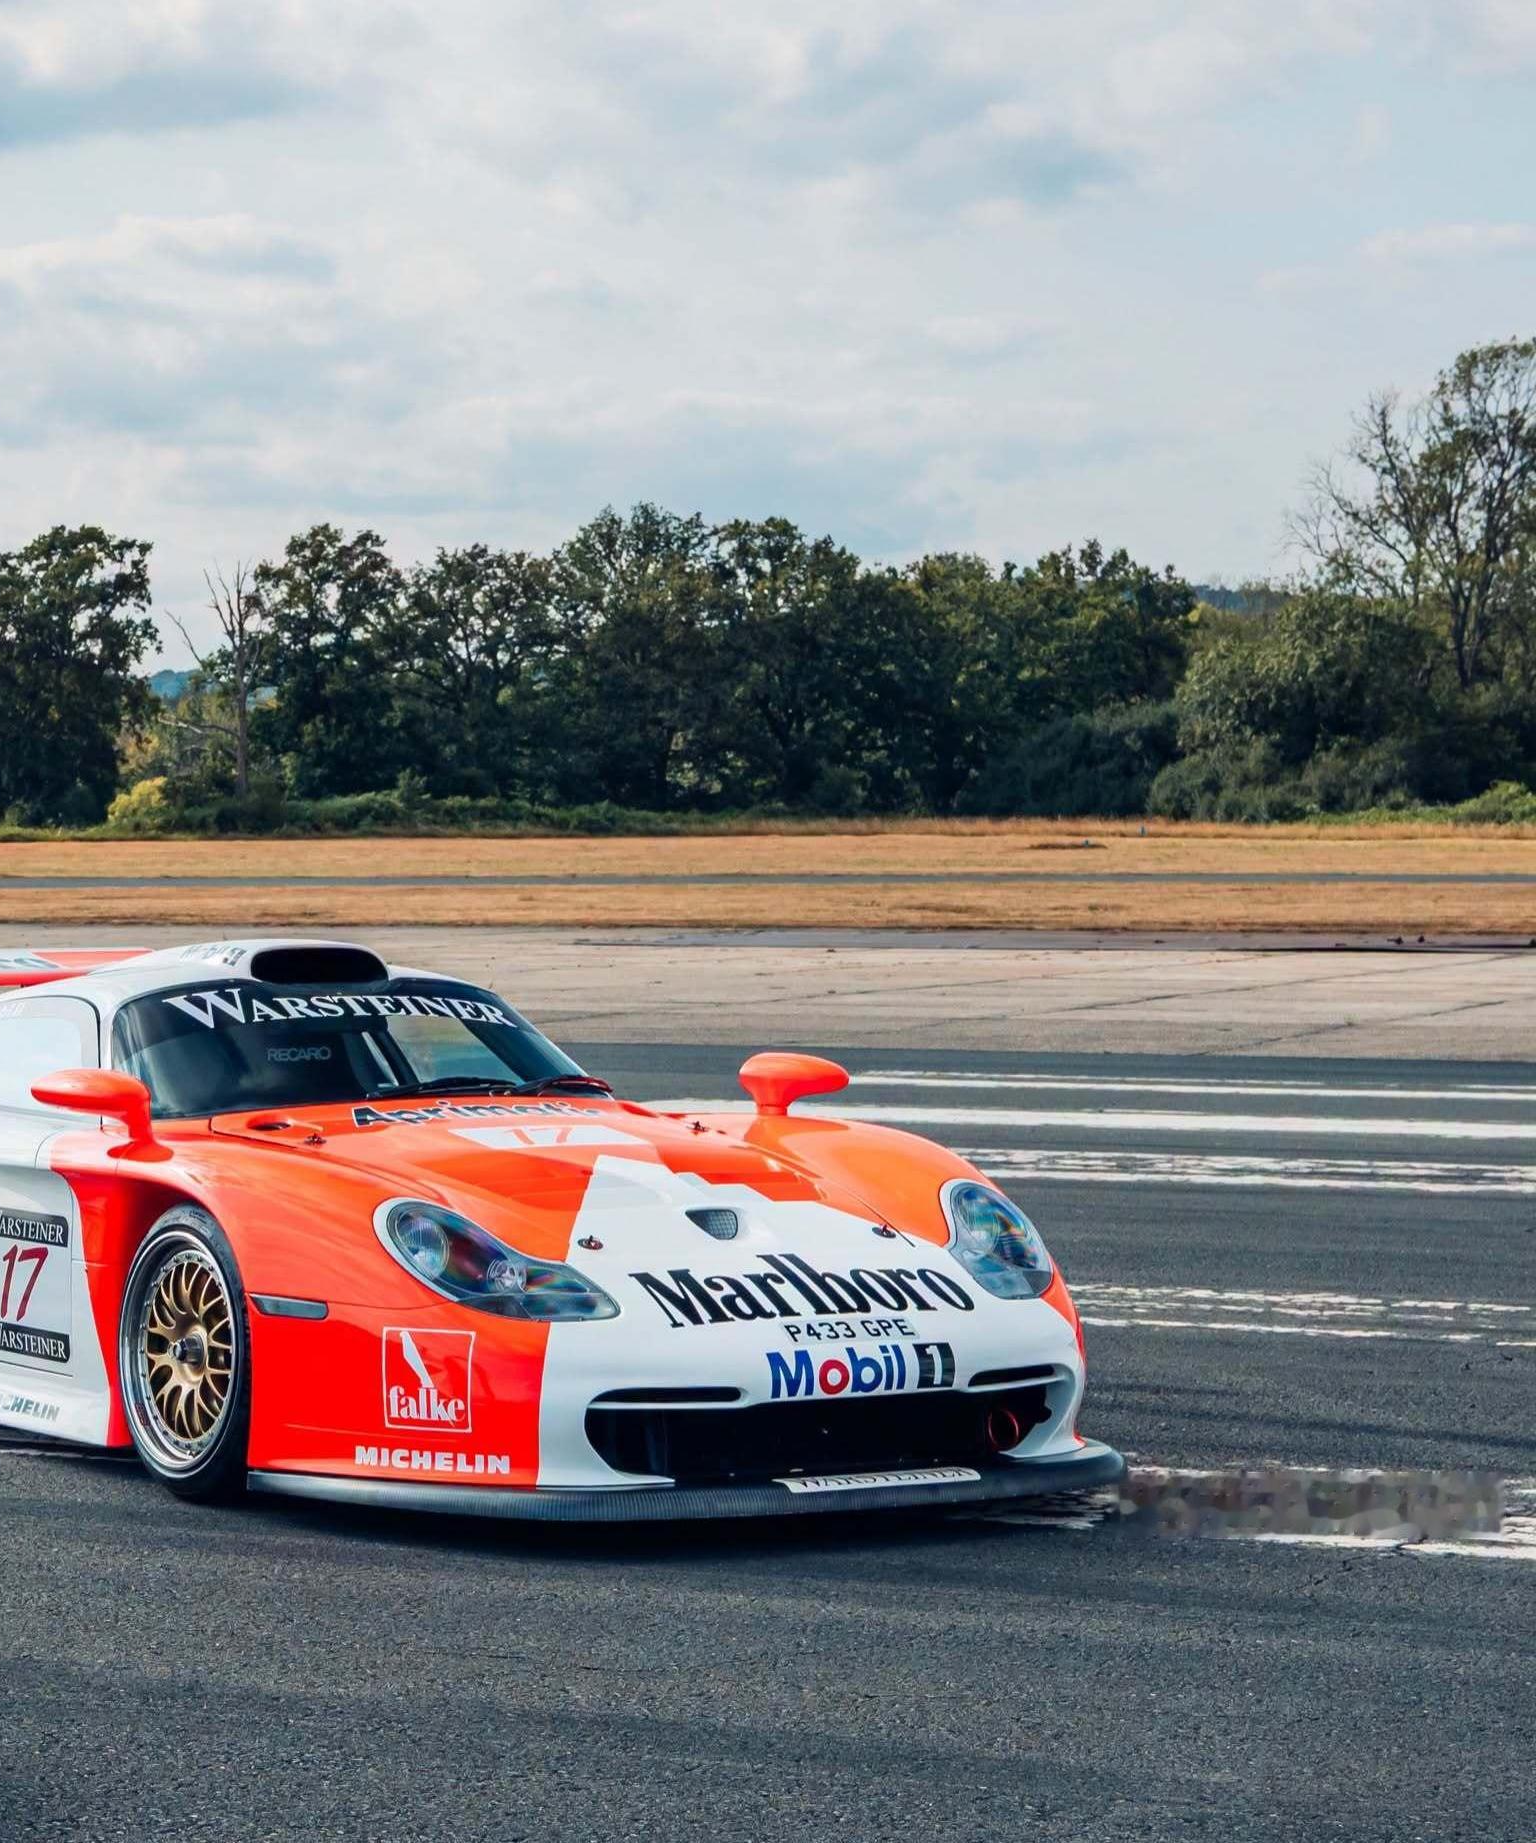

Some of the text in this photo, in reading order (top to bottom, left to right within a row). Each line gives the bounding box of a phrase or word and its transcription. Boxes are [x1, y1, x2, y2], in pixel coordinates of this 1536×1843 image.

[163, 988, 518, 1030] WARSTEINER
[267, 1046, 332, 1062] RECARO
[1, 1244, 49, 1322] 17
[628, 1254, 975, 1328] Marlboro
[784, 1318, 915, 1343] P433 GPE
[766, 1346, 907, 1399] Mobil
[388, 1386, 466, 1424] falke
[354, 1445, 510, 1475] MICHELIN
